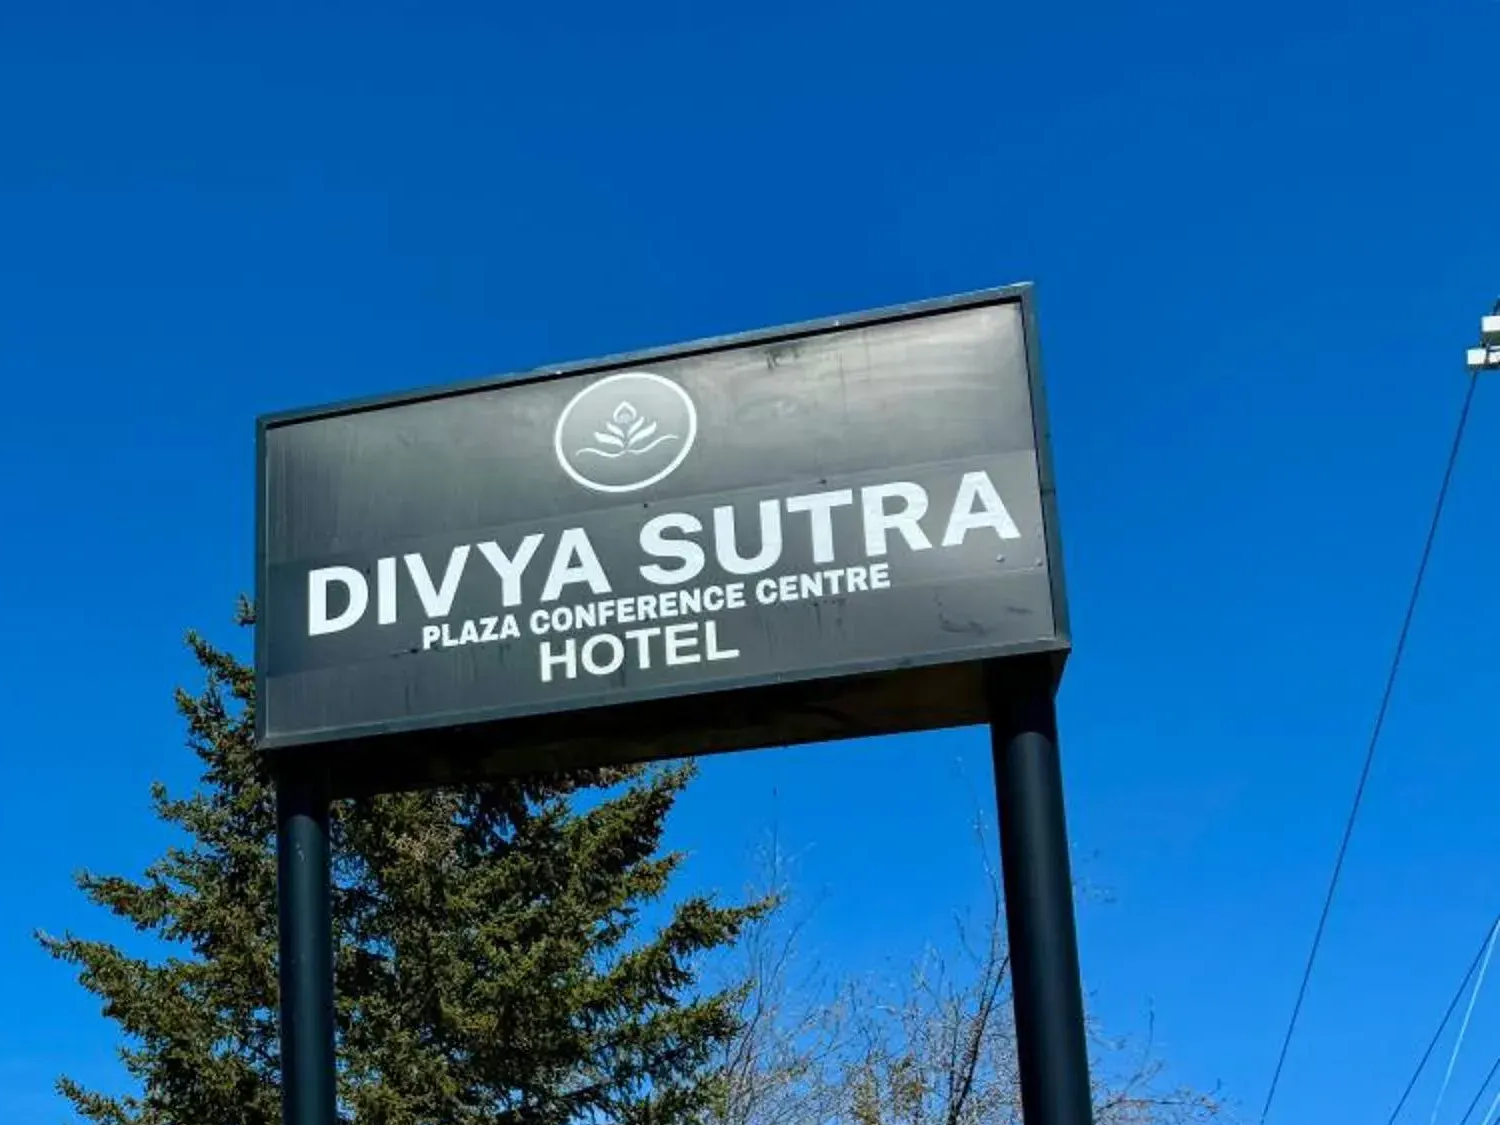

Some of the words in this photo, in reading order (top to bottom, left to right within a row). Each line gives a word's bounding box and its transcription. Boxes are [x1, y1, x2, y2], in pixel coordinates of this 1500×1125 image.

[308, 527, 613, 636] DIVYA
[639, 470, 1021, 585] SUTRA
[422, 615, 521, 651] PLAZA
[529, 582, 746, 636] CONFERENCE
[755, 563, 891, 605] CENTRE
[540, 620, 740, 683] HOTEL
